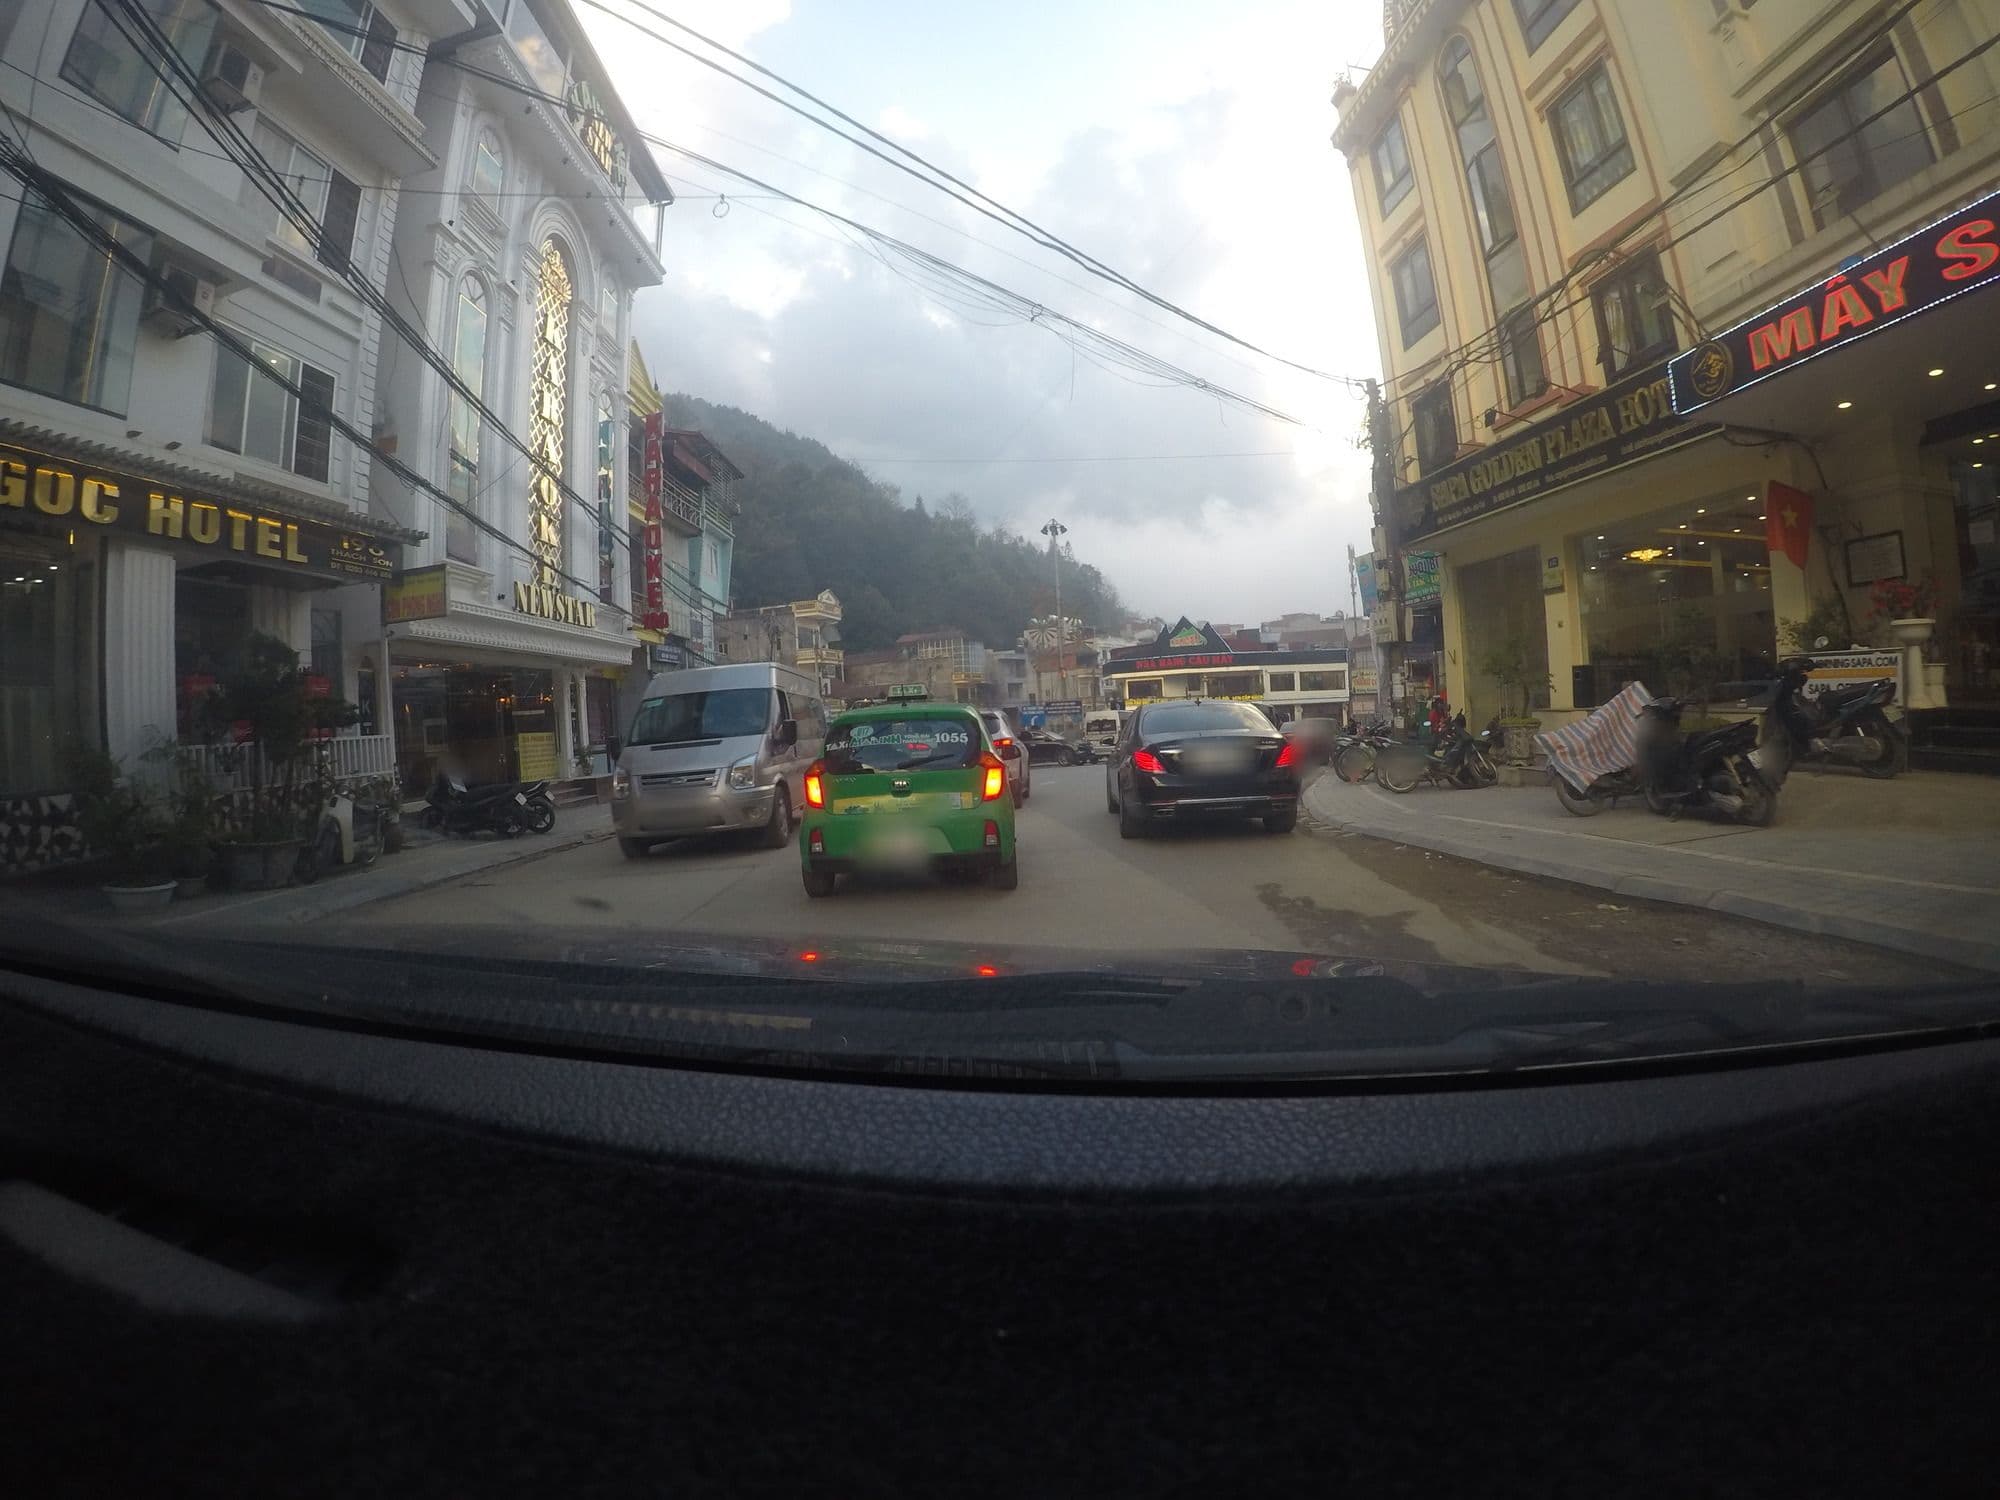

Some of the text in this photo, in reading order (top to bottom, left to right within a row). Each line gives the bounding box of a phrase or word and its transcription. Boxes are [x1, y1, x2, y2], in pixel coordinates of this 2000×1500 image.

[1748, 255, 1909, 371] MÂY
[1469, 437, 1543, 498] GOLDEN
[1546, 406, 1616, 465] PLAZA
[148, 493, 308, 563] HOTEL
[934, 732, 969, 743] 1055
